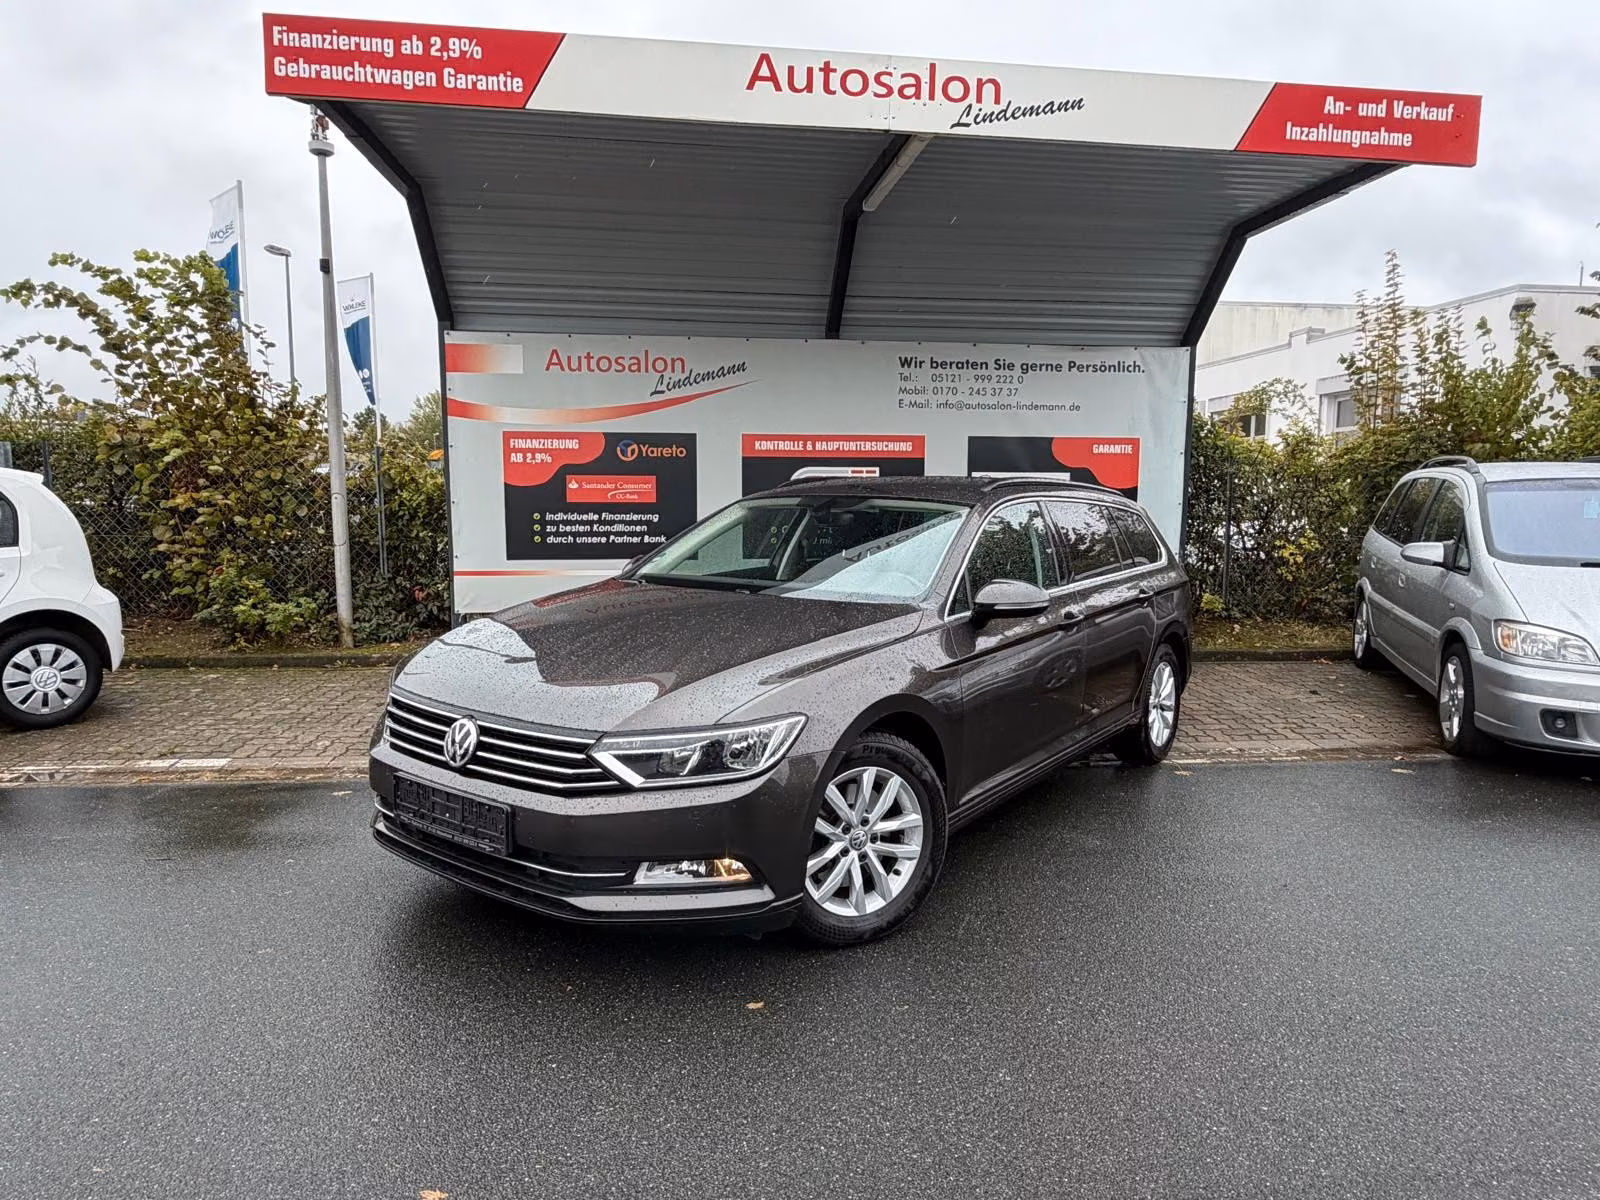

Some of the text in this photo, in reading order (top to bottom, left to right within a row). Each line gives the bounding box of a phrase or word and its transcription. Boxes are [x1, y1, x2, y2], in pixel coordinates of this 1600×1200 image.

[272, 26, 482, 60] Finanzierung ab 2,9%
[273, 56, 523, 94] Gebrauchtwagen Garantie
[745, 52, 1001, 106] Autosalon
[950, 96, 1086, 130] Lindemann
[1324, 96, 1455, 122] An- und Verkauf
[1286, 121, 1413, 148] Inzahlungnahme
[545, 348, 687, 374] Autosalon
[898, 356, 1146, 375] Wir beraten Sie gerne Persönlich.
[650, 361, 748, 397] Lindemann
[898, 372, 918, 384] Tel.:
[931, 373, 963, 384] 05121
[973, 374, 993, 384] 999
[996, 374, 1015, 385] 222
[1017, 375, 1024, 385] 0
[898, 385, 929, 396] Mobil:
[932, 386, 958, 397] 0170
[968, 387, 987, 397] 245
[990, 387, 1004, 397] 37
[1006, 387, 1019, 397] 37
[898, 398, 1081, 412] E-Mail: info@autosalon-lindemann.de
[510, 438, 579, 450] FINANZIERUNG
[640, 444, 687, 458] Yareto
[754, 440, 913, 453] KONTROLLE & HAUPTUNTERSUCHUNG
[1092, 443, 1133, 455] GARANTIE
[510, 452, 552, 465] AB 2,9%
[582, 481, 652, 490] Santander Consumer
[545, 512, 659, 523] individuelle Finanzierung
[546, 523, 647, 533] zu besten Konditionen
[546, 535, 667, 544] durch unsere Partner Bank
